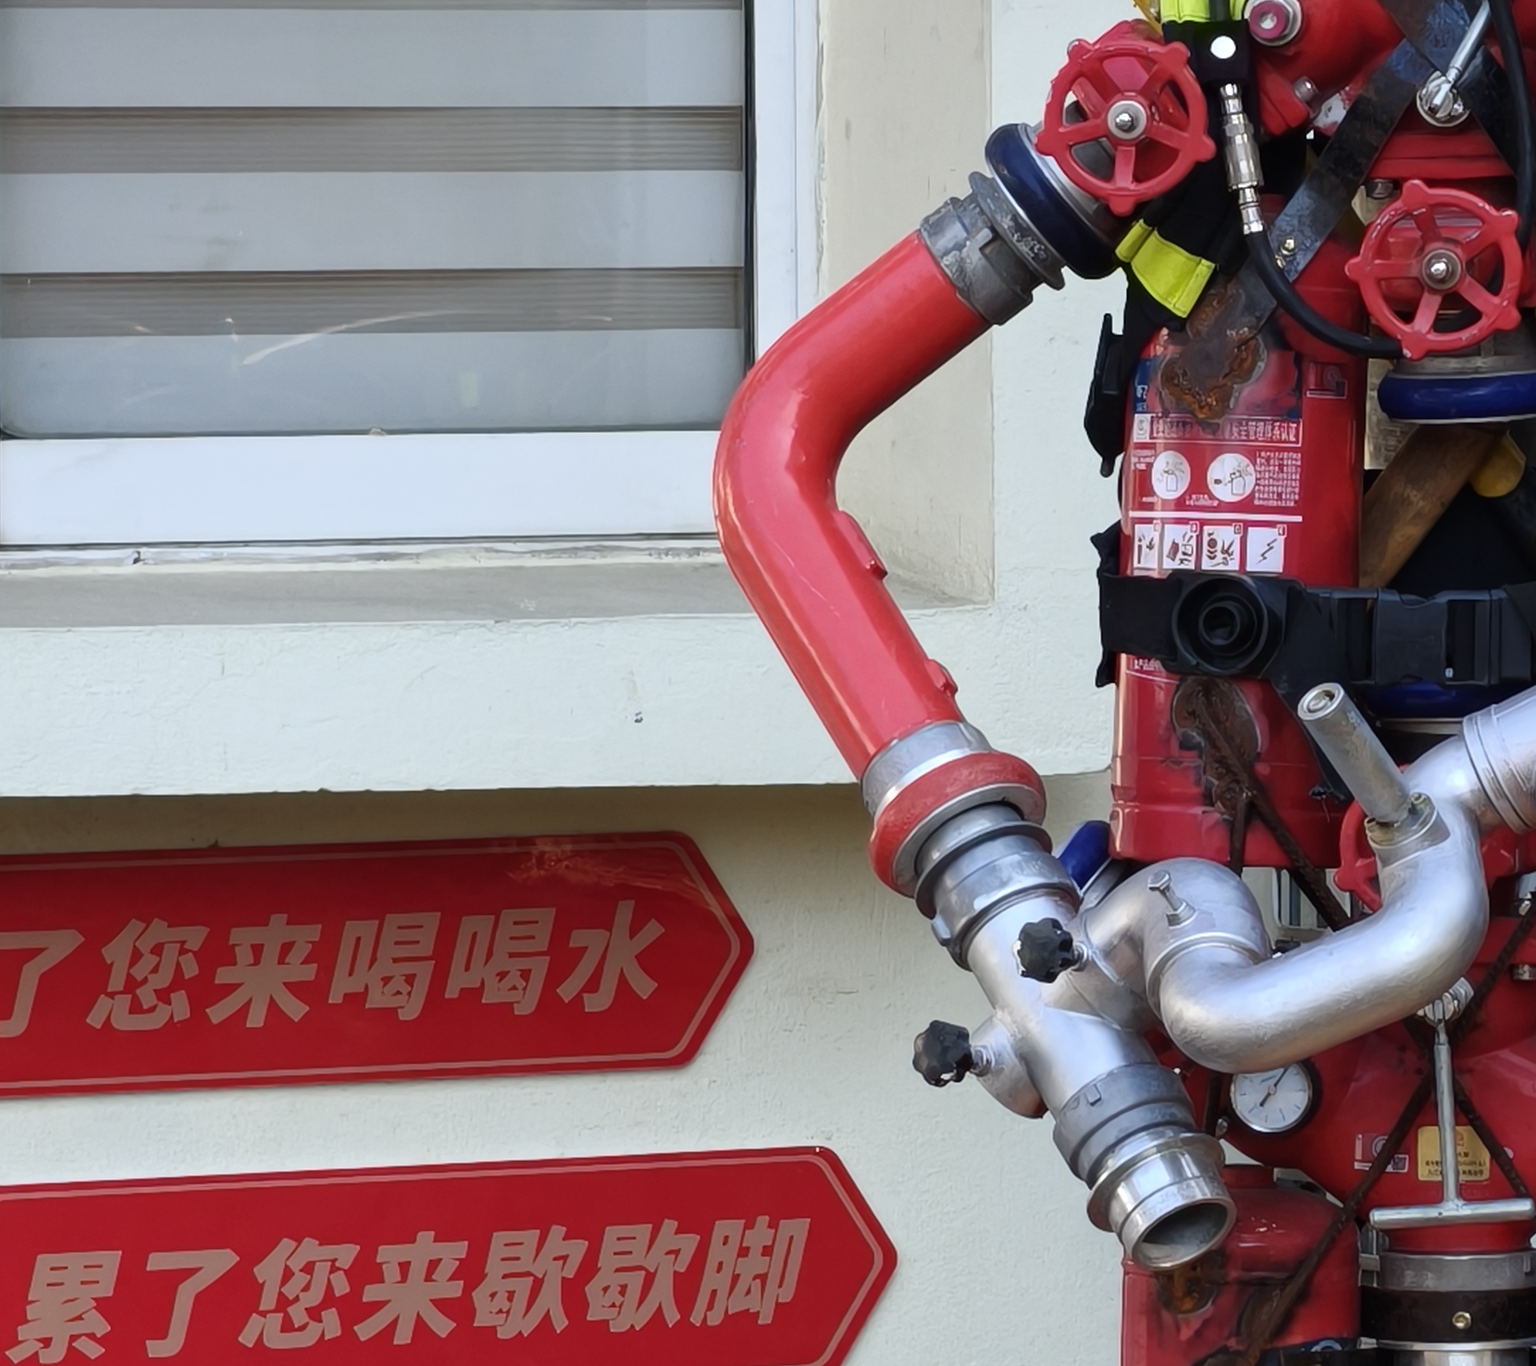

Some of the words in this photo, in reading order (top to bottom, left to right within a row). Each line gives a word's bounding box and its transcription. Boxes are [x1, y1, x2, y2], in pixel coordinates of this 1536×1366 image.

[0, 899, 667, 1035] 了您来喝喝水
[4, 1216, 812, 1365] 累了您来歇歇脚
